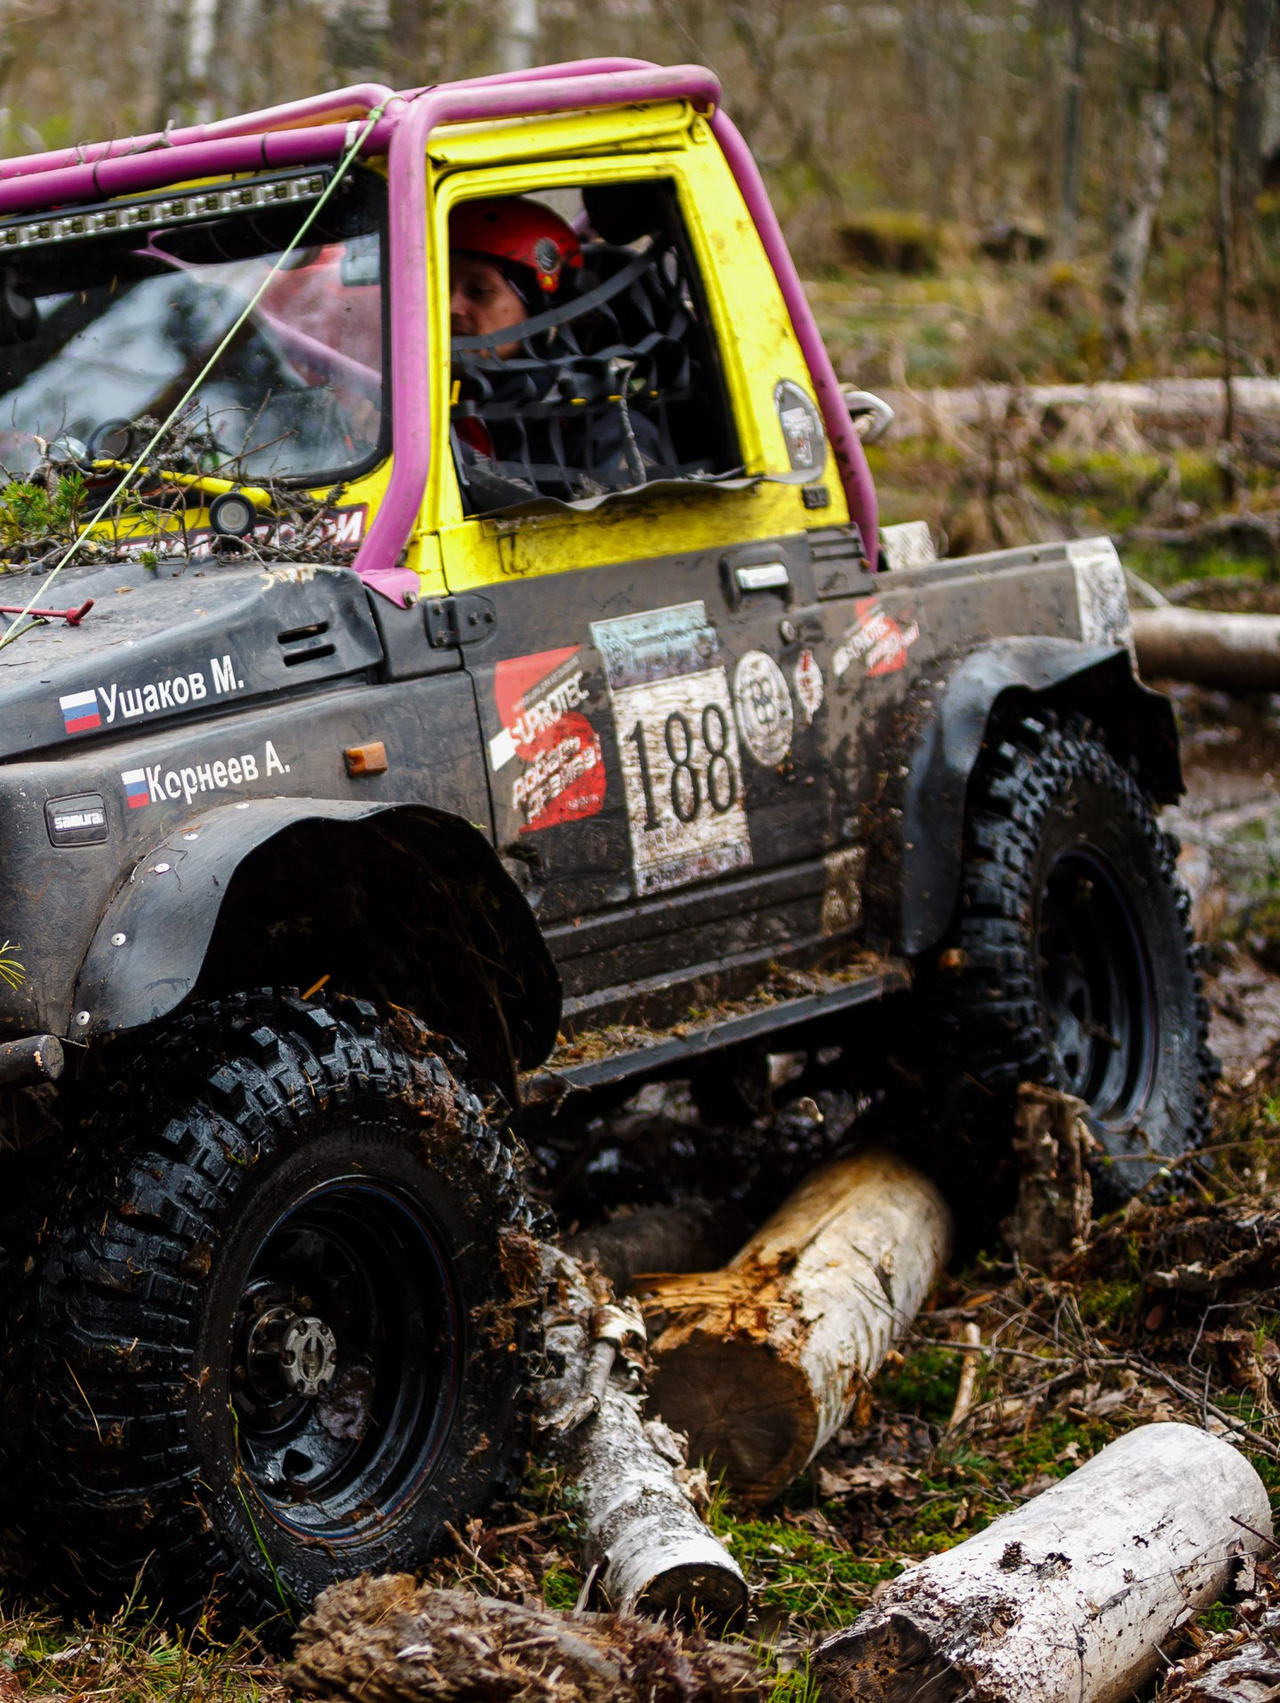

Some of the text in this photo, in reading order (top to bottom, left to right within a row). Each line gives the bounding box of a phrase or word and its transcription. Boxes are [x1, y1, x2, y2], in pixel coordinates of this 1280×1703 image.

[97, 655, 245, 724] Ушаков М.
[144, 741, 291, 804] Корнеев А.
[628, 703, 736, 832] 188
[54, 810, 104, 829] samurai
